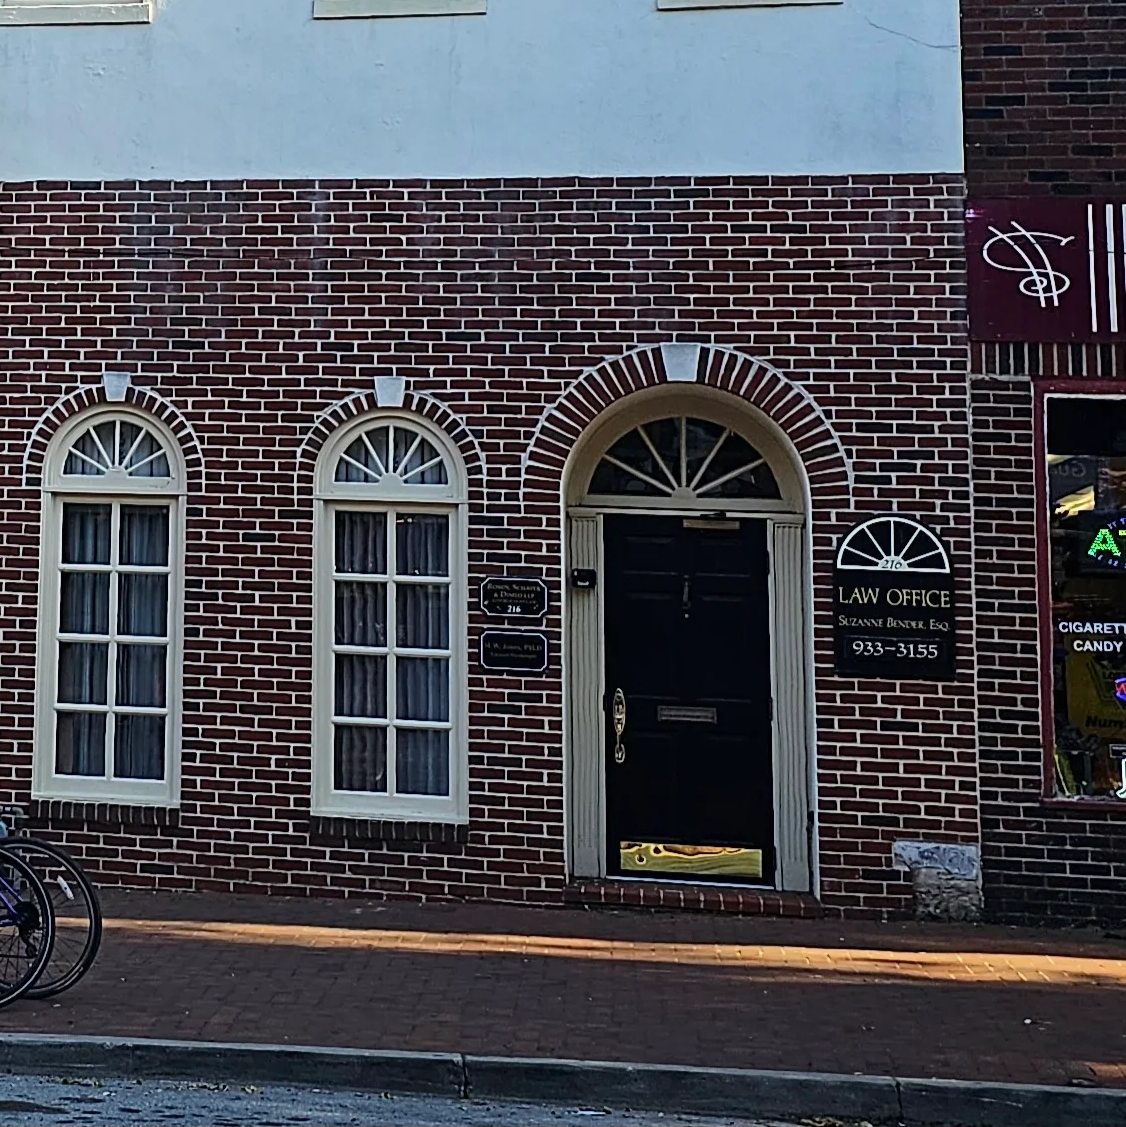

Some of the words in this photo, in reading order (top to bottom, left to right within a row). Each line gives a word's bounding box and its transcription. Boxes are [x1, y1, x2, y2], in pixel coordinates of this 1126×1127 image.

[881, 559, 903, 570] 216
[839, 586, 880, 604] LAW
[886, 588, 951, 608] OFFICE
[507, 605, 521, 613] 216
[838, 614, 884, 628] SUZANNE
[852, 640, 938, 659] 933-3155
[1073, 640, 1124, 653] CANDY
